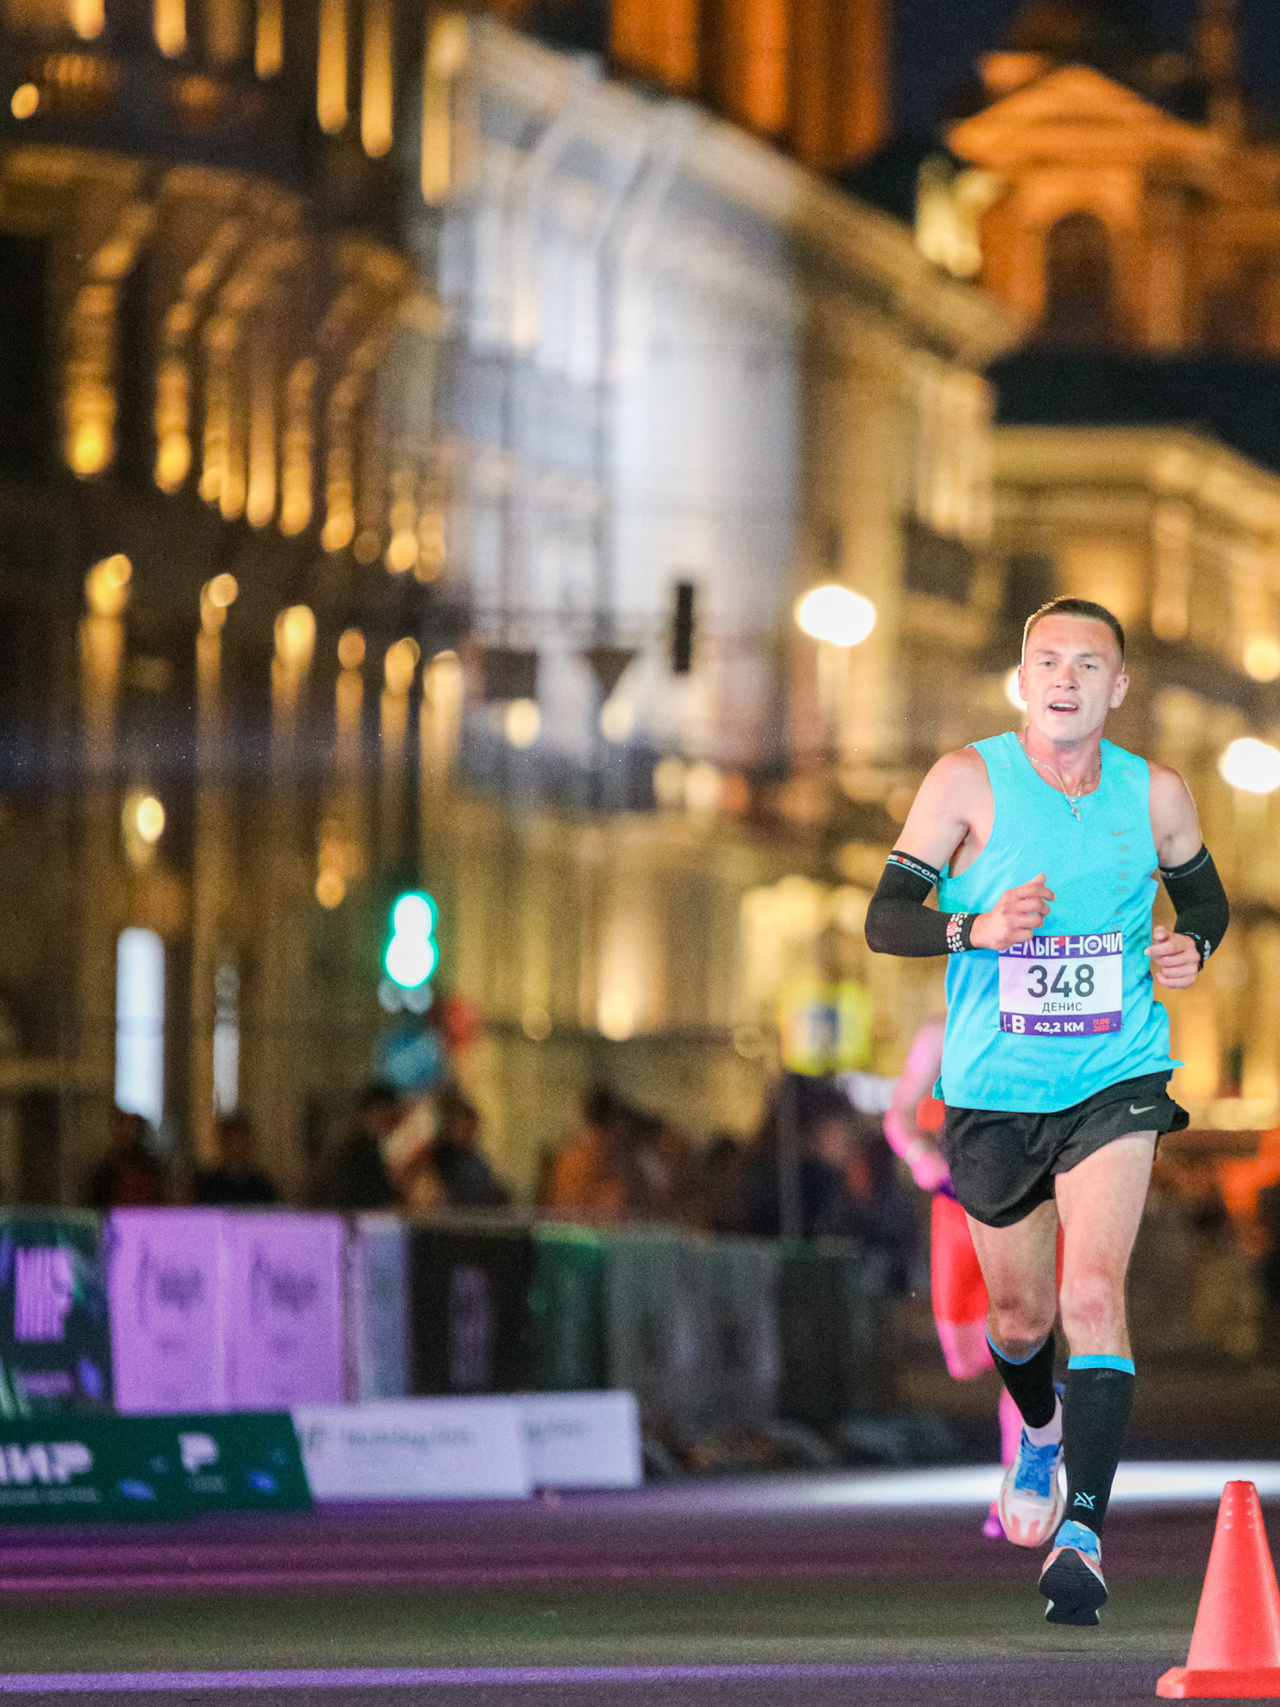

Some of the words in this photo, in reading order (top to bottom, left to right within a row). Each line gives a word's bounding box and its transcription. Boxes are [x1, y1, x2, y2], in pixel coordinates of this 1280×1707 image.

[999, 937, 1060, 956] ЕЛЫЕ
[1065, 932, 1122, 956] НОЧИ
[1028, 964, 1094, 998] 348
[1042, 1002, 1082, 1013] ДЕНИС
[1034, 1022, 1061, 1034] 42,2
[1064, 1022, 1084, 1032] КМ
